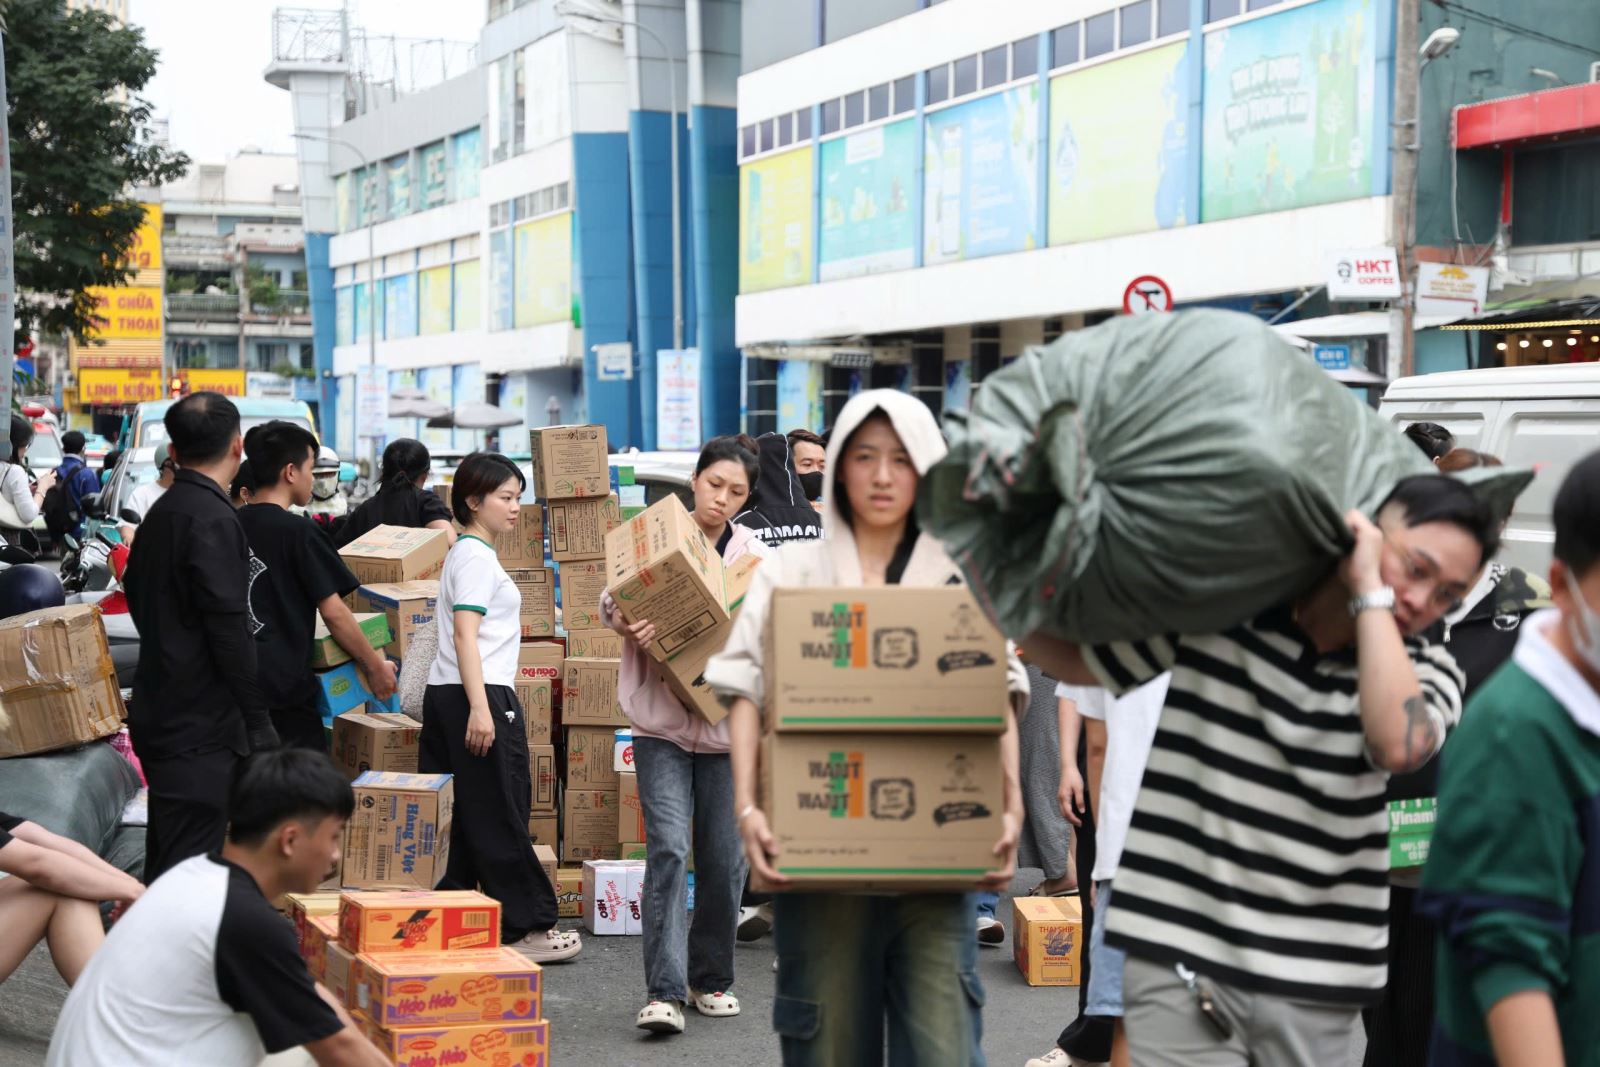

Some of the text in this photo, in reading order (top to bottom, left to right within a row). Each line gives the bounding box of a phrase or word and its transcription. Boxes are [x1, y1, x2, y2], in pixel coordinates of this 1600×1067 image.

[1356, 259, 1392, 273] HKT
[1358, 277, 1394, 285] COFFEE
[86, 384, 117, 397] LINH
[123, 382, 155, 398] KIỆN
[812, 611, 865, 628] WANT
[801, 642, 854, 659] WANT
[808, 761, 861, 779] WANT
[797, 792, 850, 809] WANT
[401, 803, 419, 874] Hàng Việt
[596, 899, 609, 919] HEO
[628, 901, 641, 920] HEO
[396, 990, 458, 1015] Hảo Hảo
[439, 1044, 468, 1065] Hảo
